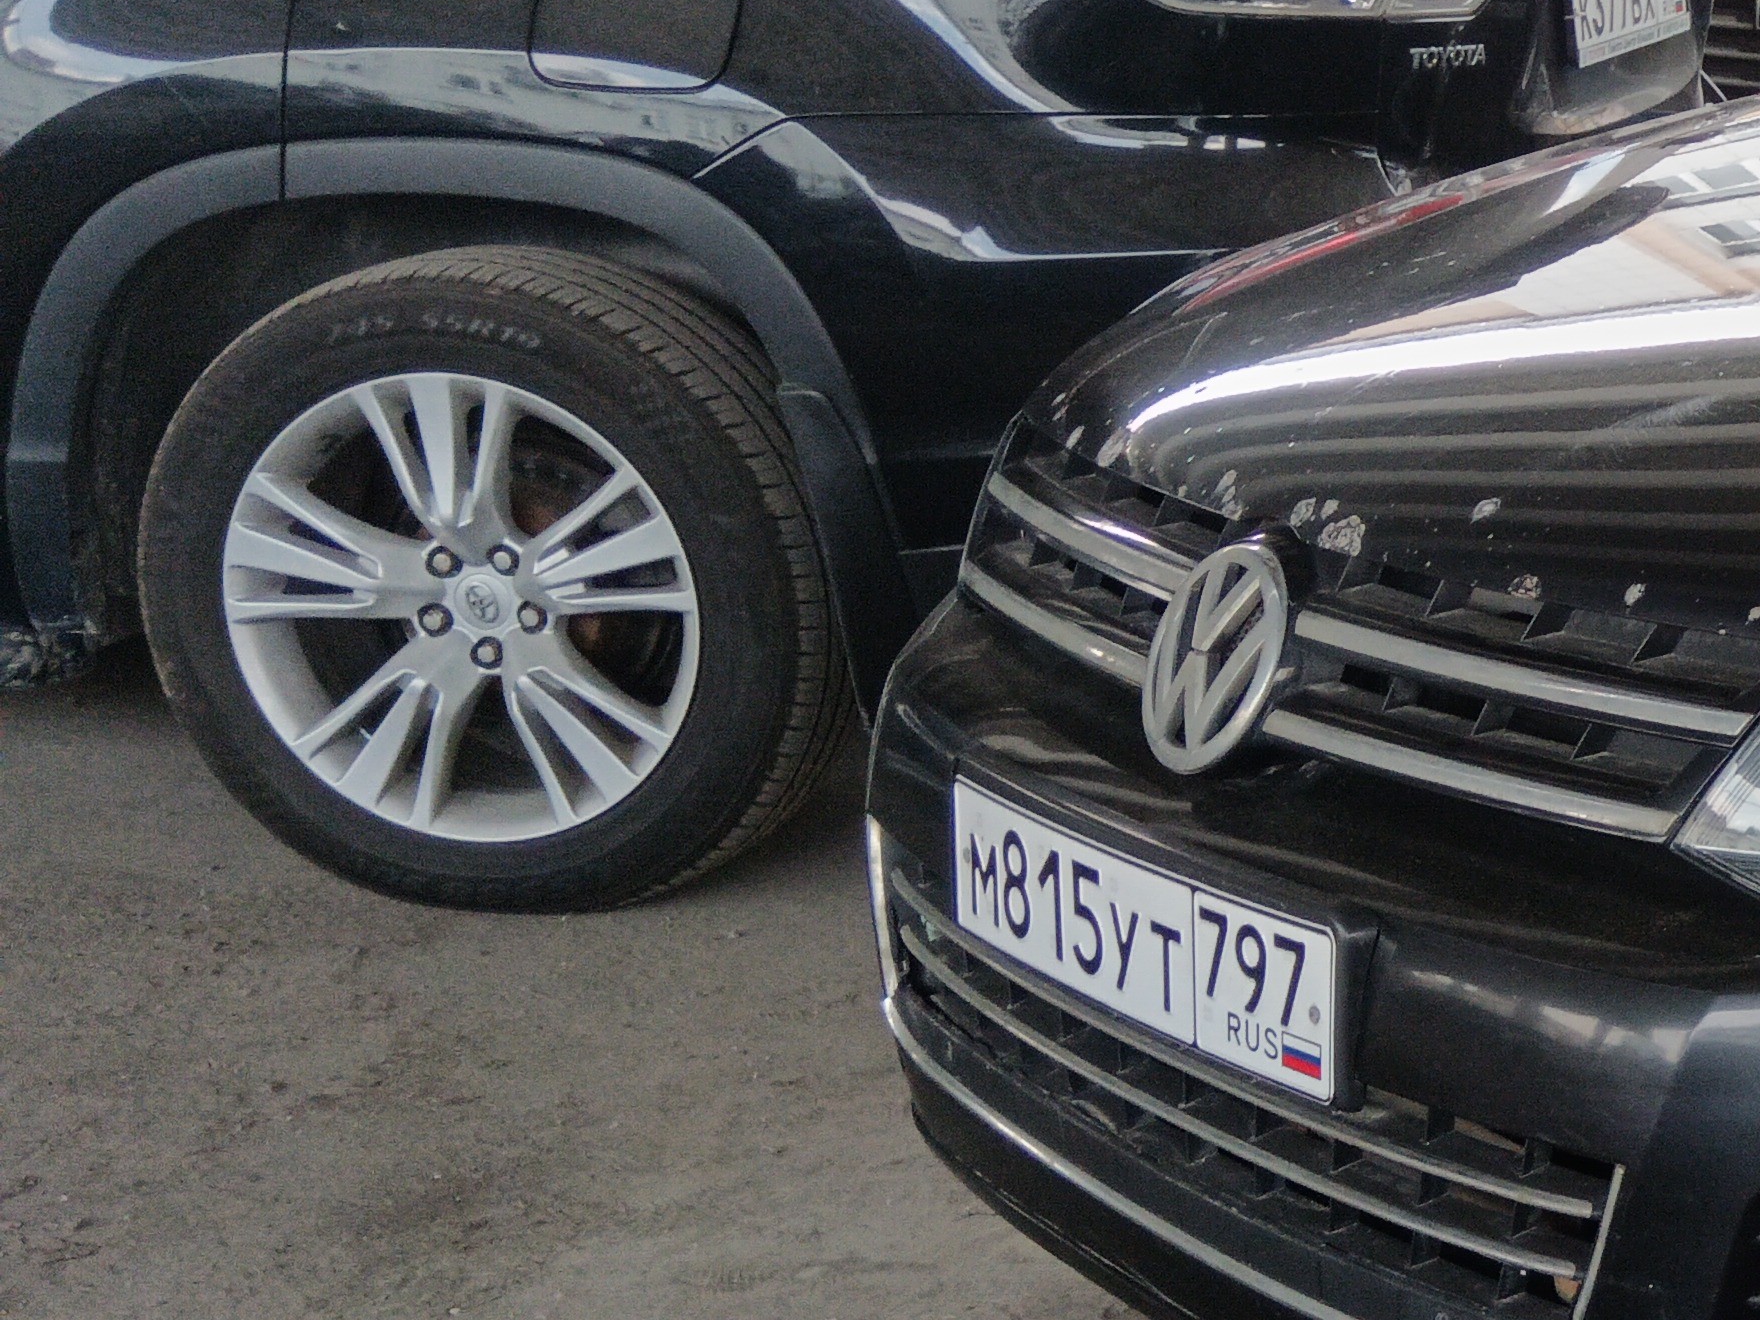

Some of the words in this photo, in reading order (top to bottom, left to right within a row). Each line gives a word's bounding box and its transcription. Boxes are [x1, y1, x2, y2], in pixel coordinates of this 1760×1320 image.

[1409, 44, 1486, 70] TOYOTA
[969, 829, 1182, 1013] М815УТ
[1198, 905, 1307, 1027] 797
[1227, 1011, 1279, 1061] RUS
